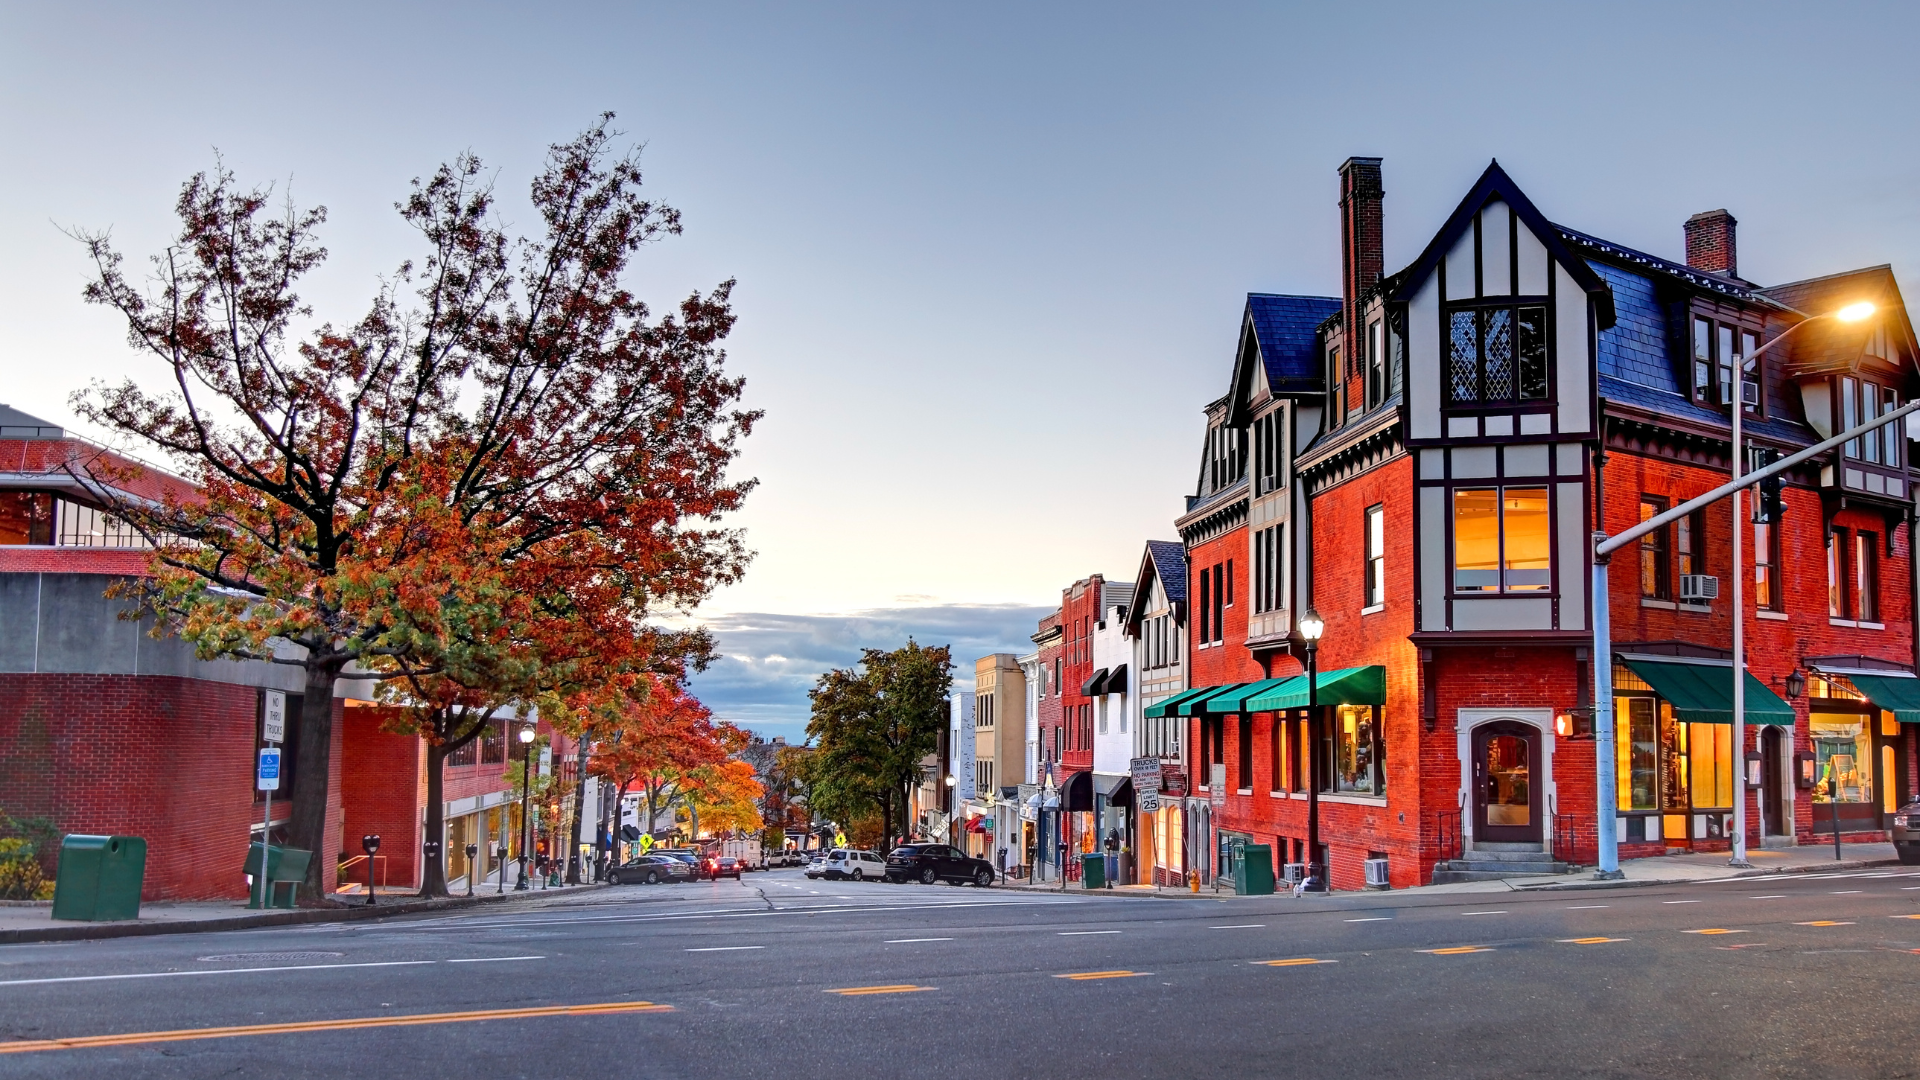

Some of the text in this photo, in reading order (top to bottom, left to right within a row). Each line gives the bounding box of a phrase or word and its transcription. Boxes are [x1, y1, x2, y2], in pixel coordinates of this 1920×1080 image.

[272, 697, 279, 707] NO
[270, 710, 281, 721] THRU
[267, 724, 282, 736] TRUCKS
[1144, 800, 1158, 809] 25
